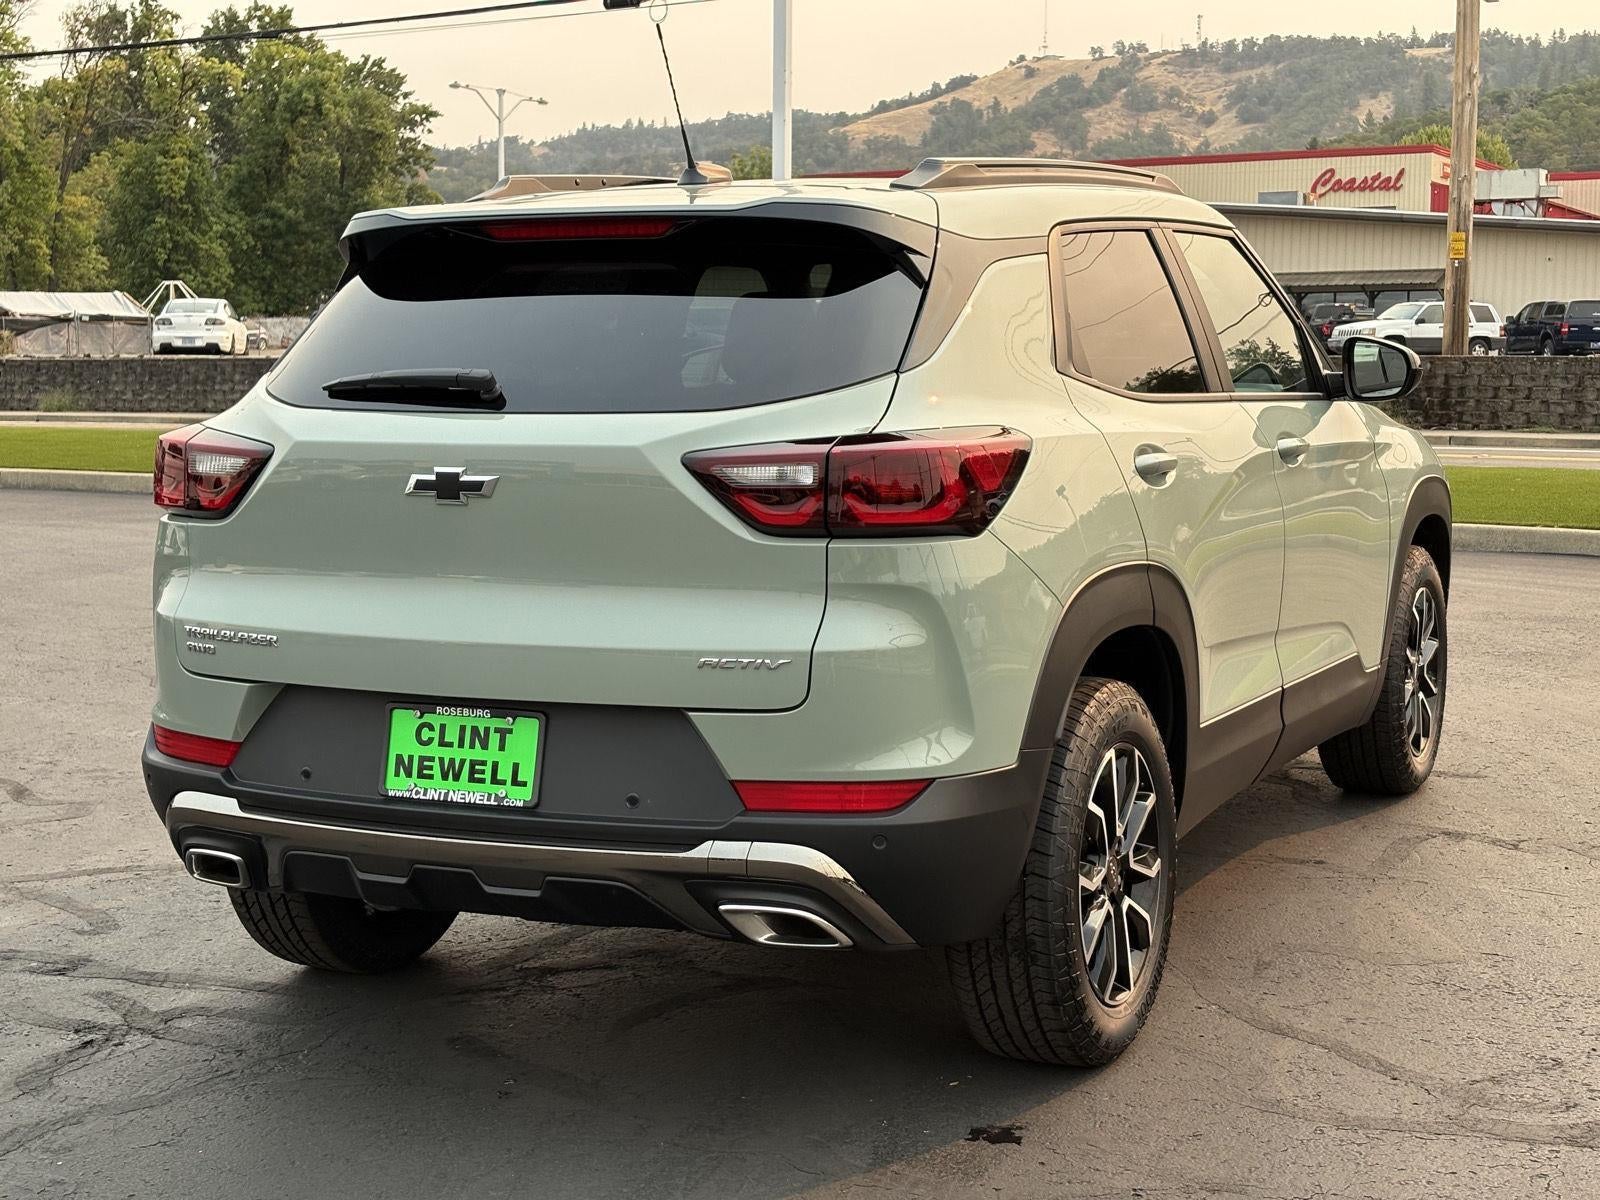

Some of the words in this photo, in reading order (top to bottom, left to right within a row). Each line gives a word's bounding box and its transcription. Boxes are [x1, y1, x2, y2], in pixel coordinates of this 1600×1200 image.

[1310, 168, 1405, 198] Coastal
[183, 625, 279, 647] TRAILBLAZER
[697, 657, 792, 670] ACTIV
[436, 706, 491, 718] ROSEBURG
[414, 721, 514, 752] CLINT
[393, 753, 528, 788] NEWELL
